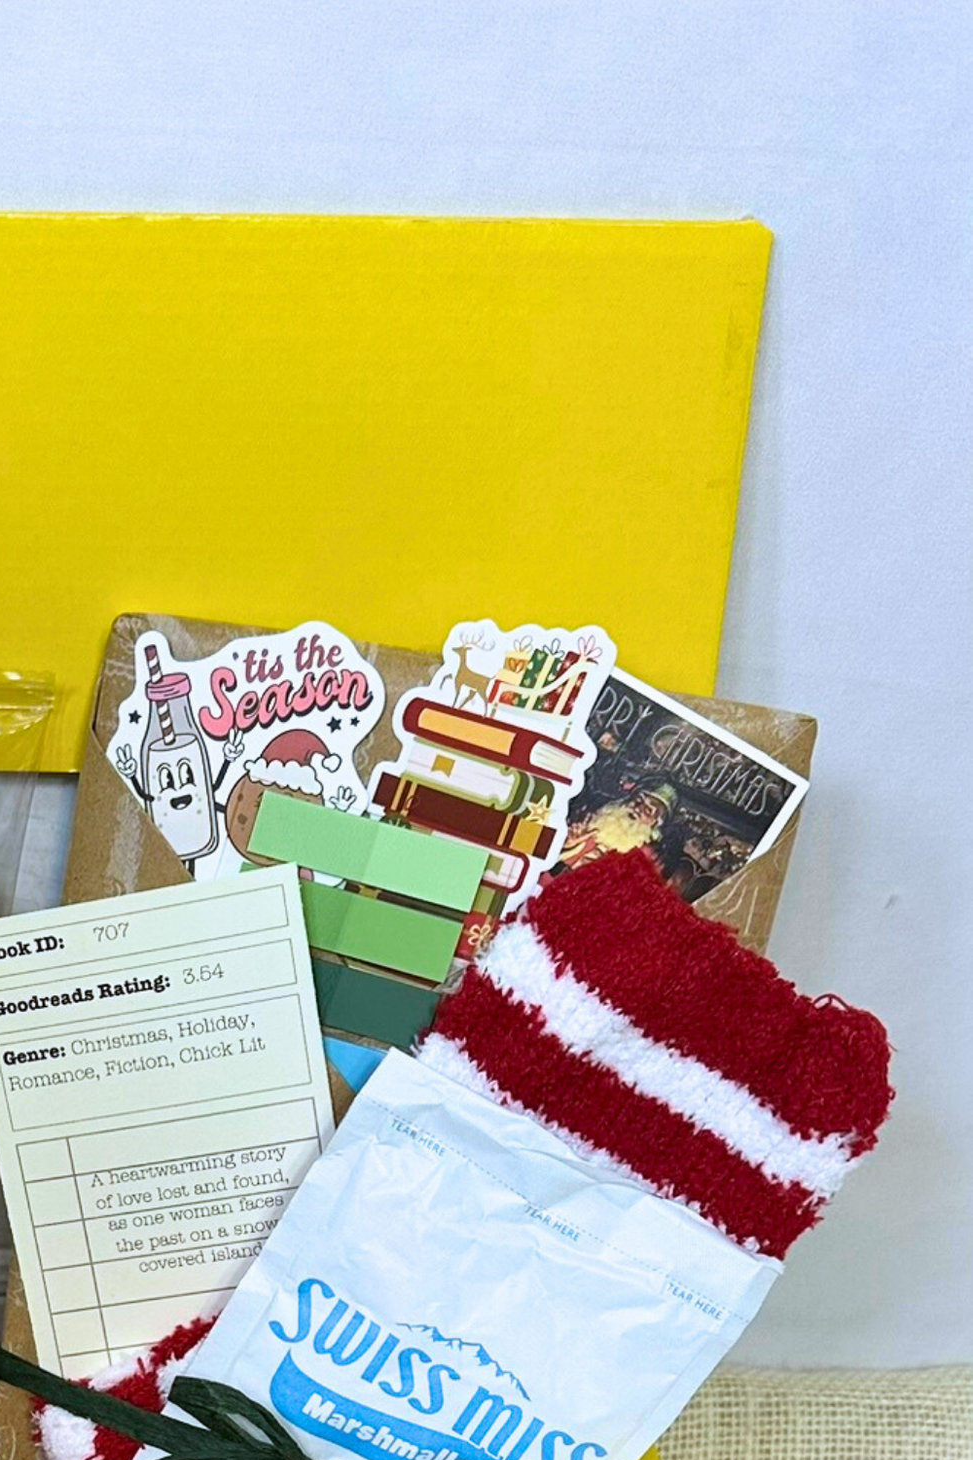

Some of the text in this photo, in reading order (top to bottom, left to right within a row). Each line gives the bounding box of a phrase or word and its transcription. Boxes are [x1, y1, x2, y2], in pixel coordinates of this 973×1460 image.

[294, 634, 344, 672] the
[199, 667, 373, 741] Season
[651, 723, 781, 816] CHRISTMAS
[34, 935, 65, 953] ID:
[93, 922, 130, 943] 707
[98, 974, 171, 1000] Rating:
[182, 963, 225, 985] 3.54
[2, 1013, 256, 1066] Genre: Christmas, Holiday,
[8, 1036, 266, 1092] Romance, Fiction, Chick Lit
[390, 1118, 446, 1157] TEAR HERE
[90, 1146, 287, 1188] A heartwarming story
[96, 1169, 290, 1210] of love lost and found,
[108, 1194, 284, 1231] as one woman faces
[525, 1205, 581, 1242] TEAR HERE
[116, 1237, 144, 1254] the
[149, 1230, 186, 1252] past
[189, 1227, 214, 1241] on
[217, 1225, 229, 1238] a
[138, 1242, 263, 1273] covered island
[667, 1282, 723, 1320] TEAR HERE
[269, 1278, 461, 1415] SWISS
